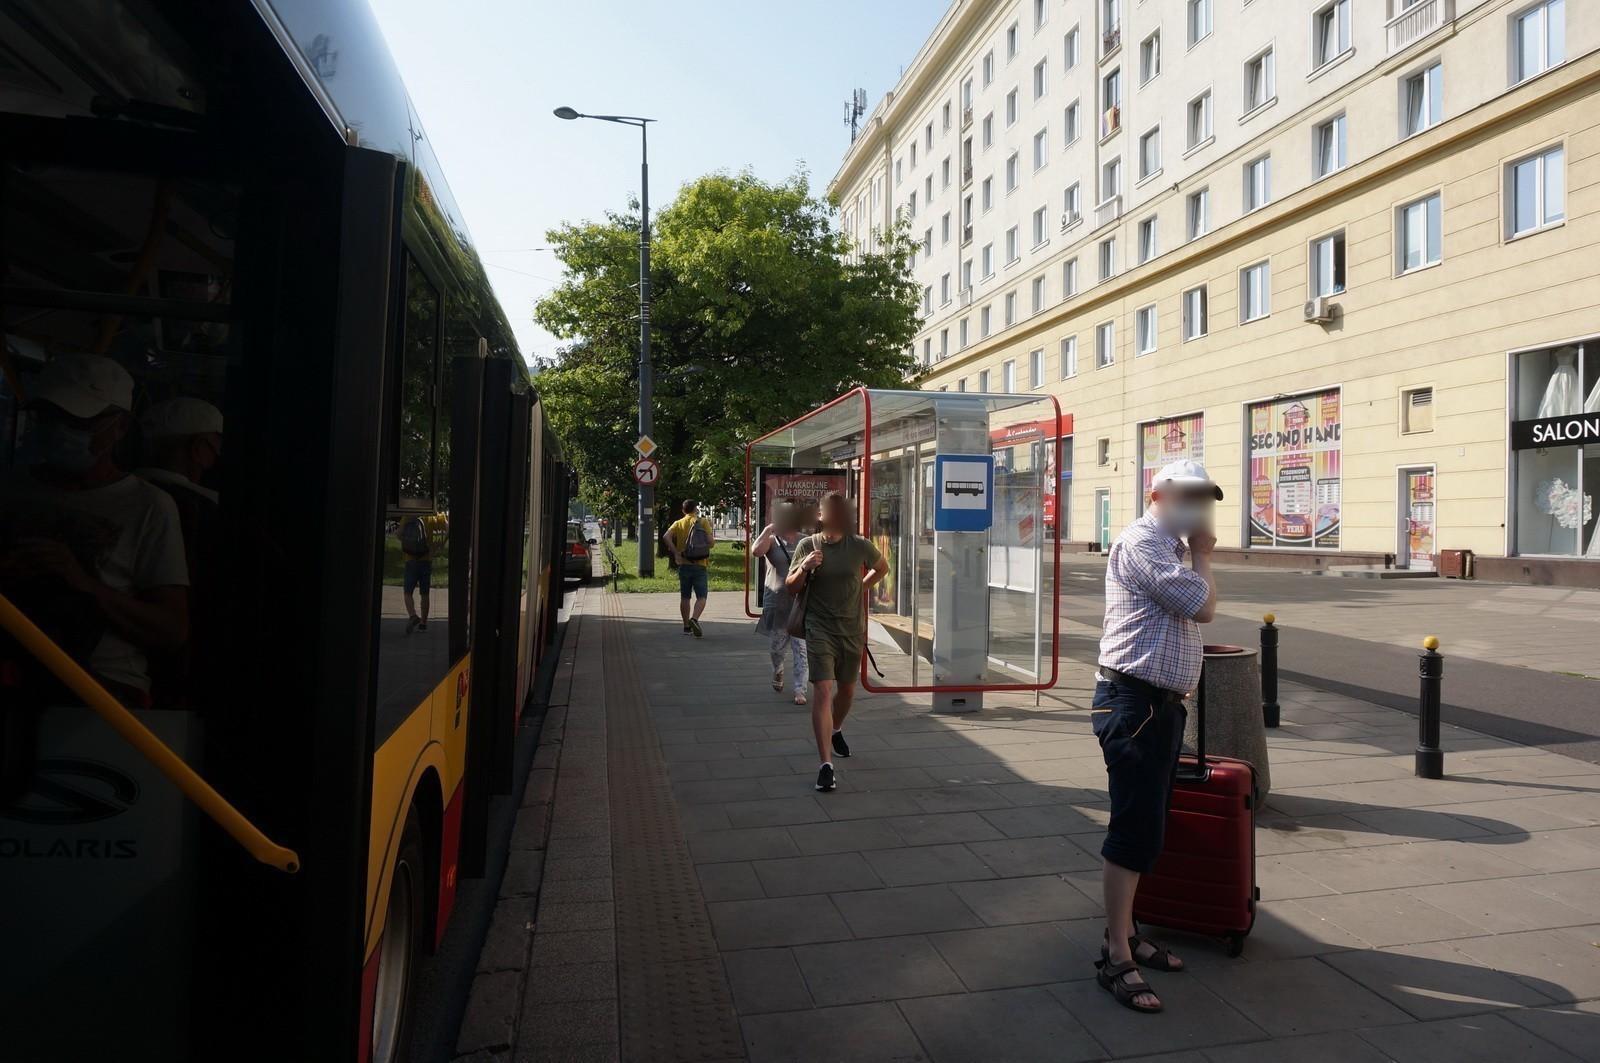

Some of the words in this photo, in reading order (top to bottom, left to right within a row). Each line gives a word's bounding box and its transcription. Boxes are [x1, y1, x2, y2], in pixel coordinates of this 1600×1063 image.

[1251, 429, 1300, 450] SECOND
[1304, 423, 1340, 444] HAND
[1533, 418, 1600, 443] SALON
[786, 481, 828, 489] WAKACYJNE
[0, 838, 137, 858] OLARIS
